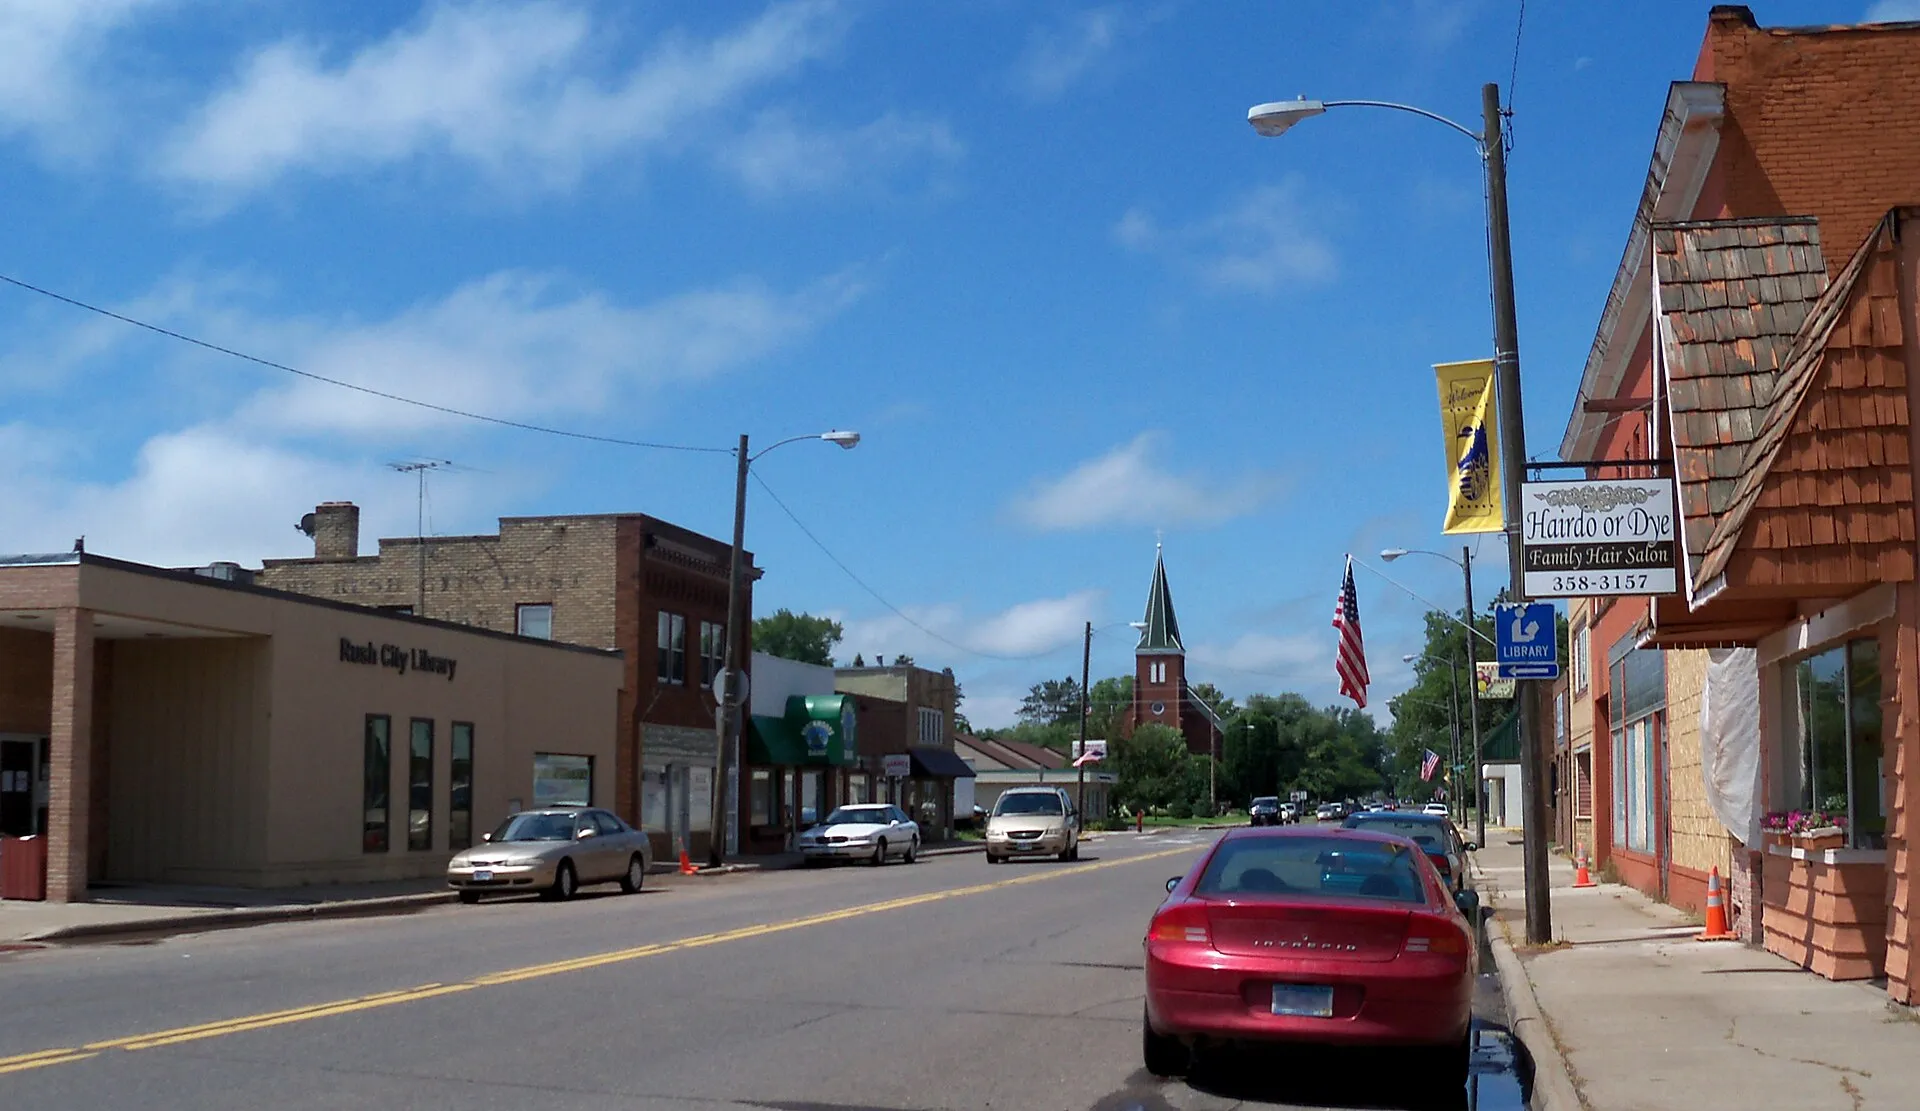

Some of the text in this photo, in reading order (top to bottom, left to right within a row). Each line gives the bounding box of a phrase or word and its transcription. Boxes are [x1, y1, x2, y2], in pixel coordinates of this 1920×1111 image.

[1526, 505, 1670, 548] Hairdo or Dye
[1529, 545, 1669, 570] Family Hair Salon
[1552, 574, 1648, 592] 358-3157
[339, 637, 457, 681] Rush City Library
[1503, 645, 1549, 658] LIBRARY
[1254, 939, 1356, 951] INTREPID
